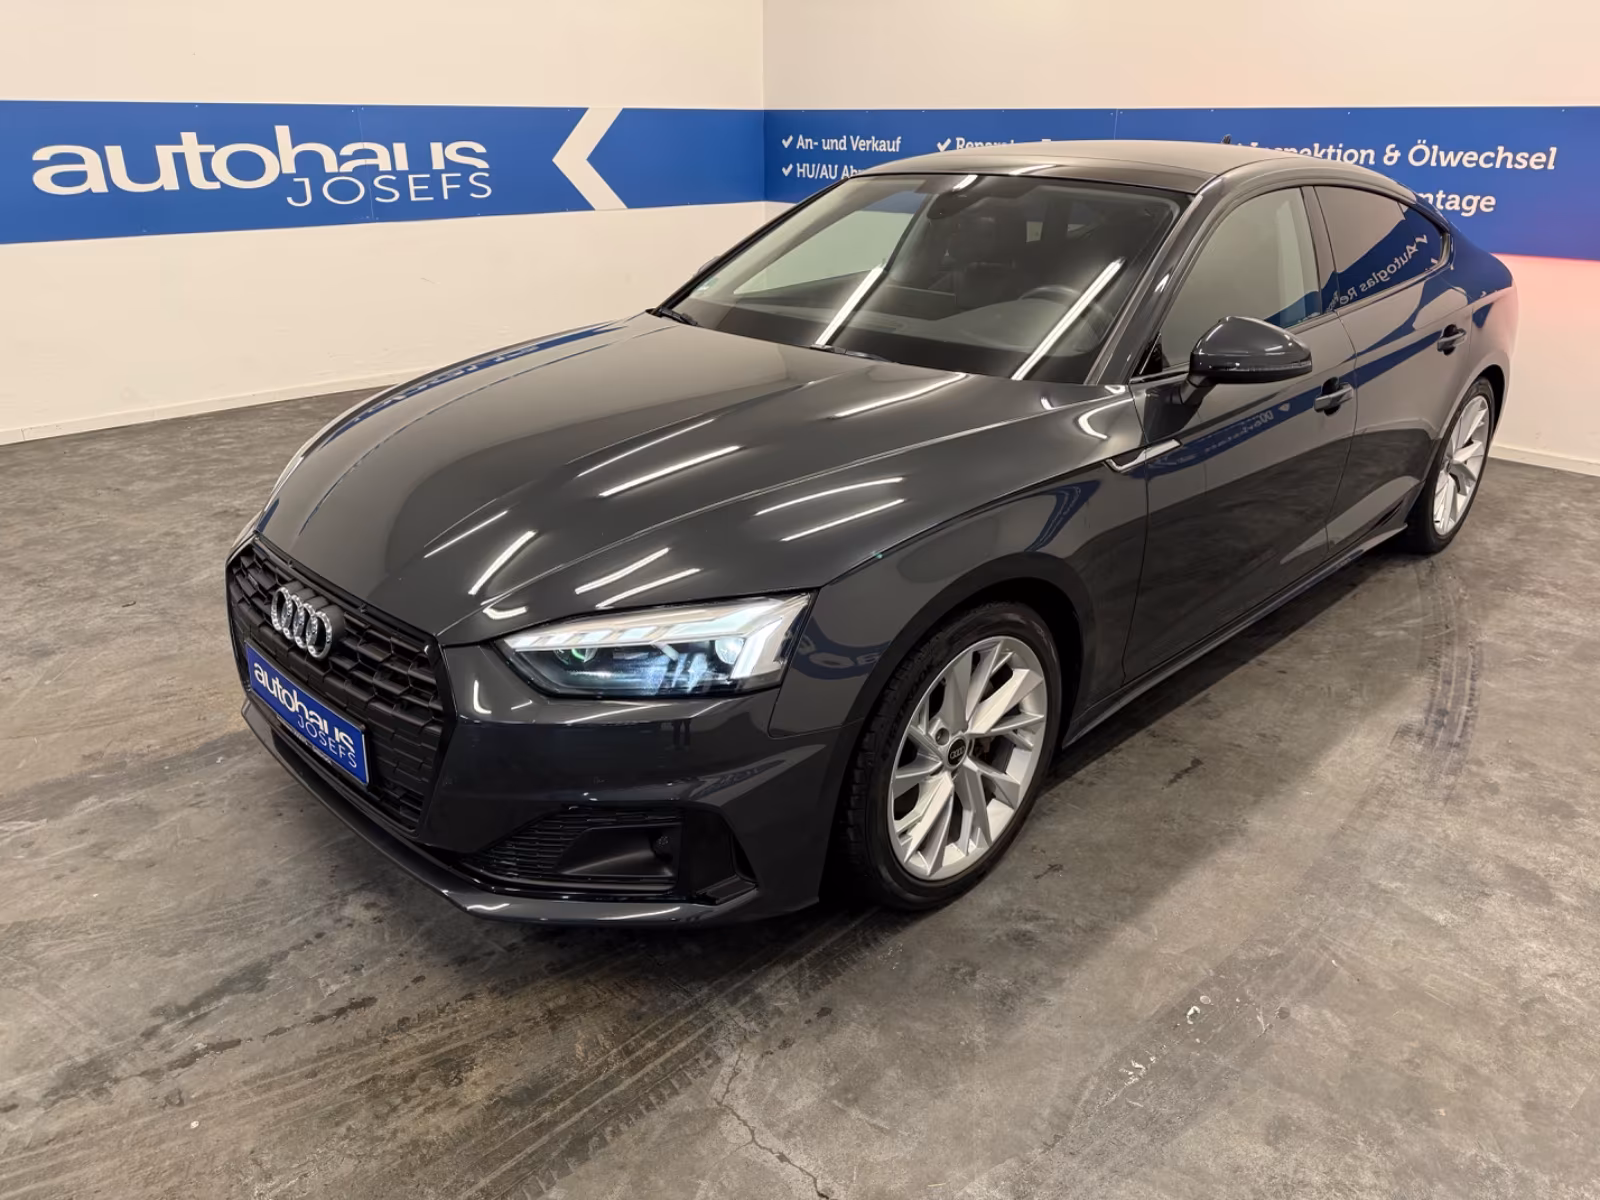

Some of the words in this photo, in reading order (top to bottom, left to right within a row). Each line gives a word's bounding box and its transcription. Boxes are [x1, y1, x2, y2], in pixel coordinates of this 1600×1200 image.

[32, 125, 489, 195] autohaus
[796, 134, 818, 150] An-
[821, 135, 847, 151] und
[849, 136, 902, 153] Verkauf
[1383, 143, 1401, 167] &
[1407, 139, 1558, 171] Ölwechsel
[796, 163, 839, 180] HU/AU
[286, 171, 493, 207] JOSEFS
[296, 714, 358, 769] JOSEFS
